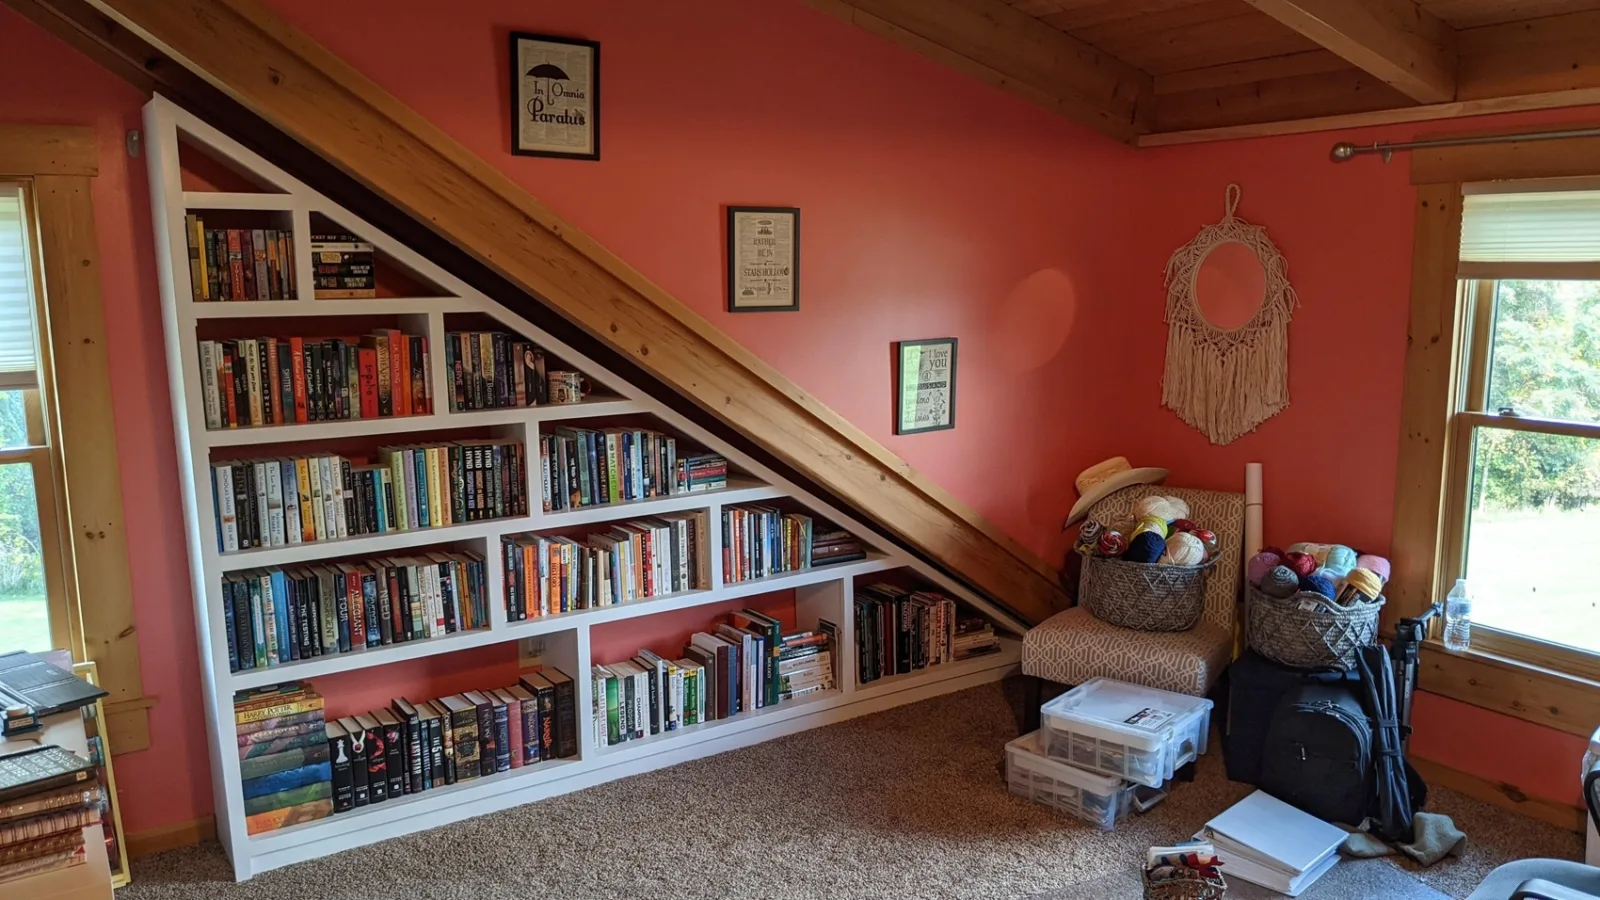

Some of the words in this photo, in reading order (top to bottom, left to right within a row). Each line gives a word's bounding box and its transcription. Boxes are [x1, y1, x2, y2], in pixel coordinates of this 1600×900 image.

[534, 80, 544, 95] In
[551, 82, 585, 99] Omnia
[527, 96, 586, 126] Paratus
[743, 268, 761, 277] STARS
[929, 358, 947, 371] you
[933, 348, 948, 358] love
[455, 360, 463, 386] NERVE
[486, 382, 494, 405] Bones
[465, 451, 473, 469] HYND
[474, 450, 482, 468] HYND
[466, 471, 474, 495] CONSPIRACY
[324, 591, 334, 639] INSURGENT
[340, 597, 348, 622] FOUR
[351, 588, 362, 636] ALLEGIANT
[368, 594, 378, 636] DIVERGENT
[380, 590, 390, 620] NEED
[302, 618, 310, 646] TESTING
[243, 710, 266, 719] HARRY
[267, 704, 292, 715] POTTER
[543, 716, 553, 748] NARNIA
[411, 740, 421, 757] LAST
[434, 752, 442, 767] WAVE
[412, 757, 422, 775] STAR
